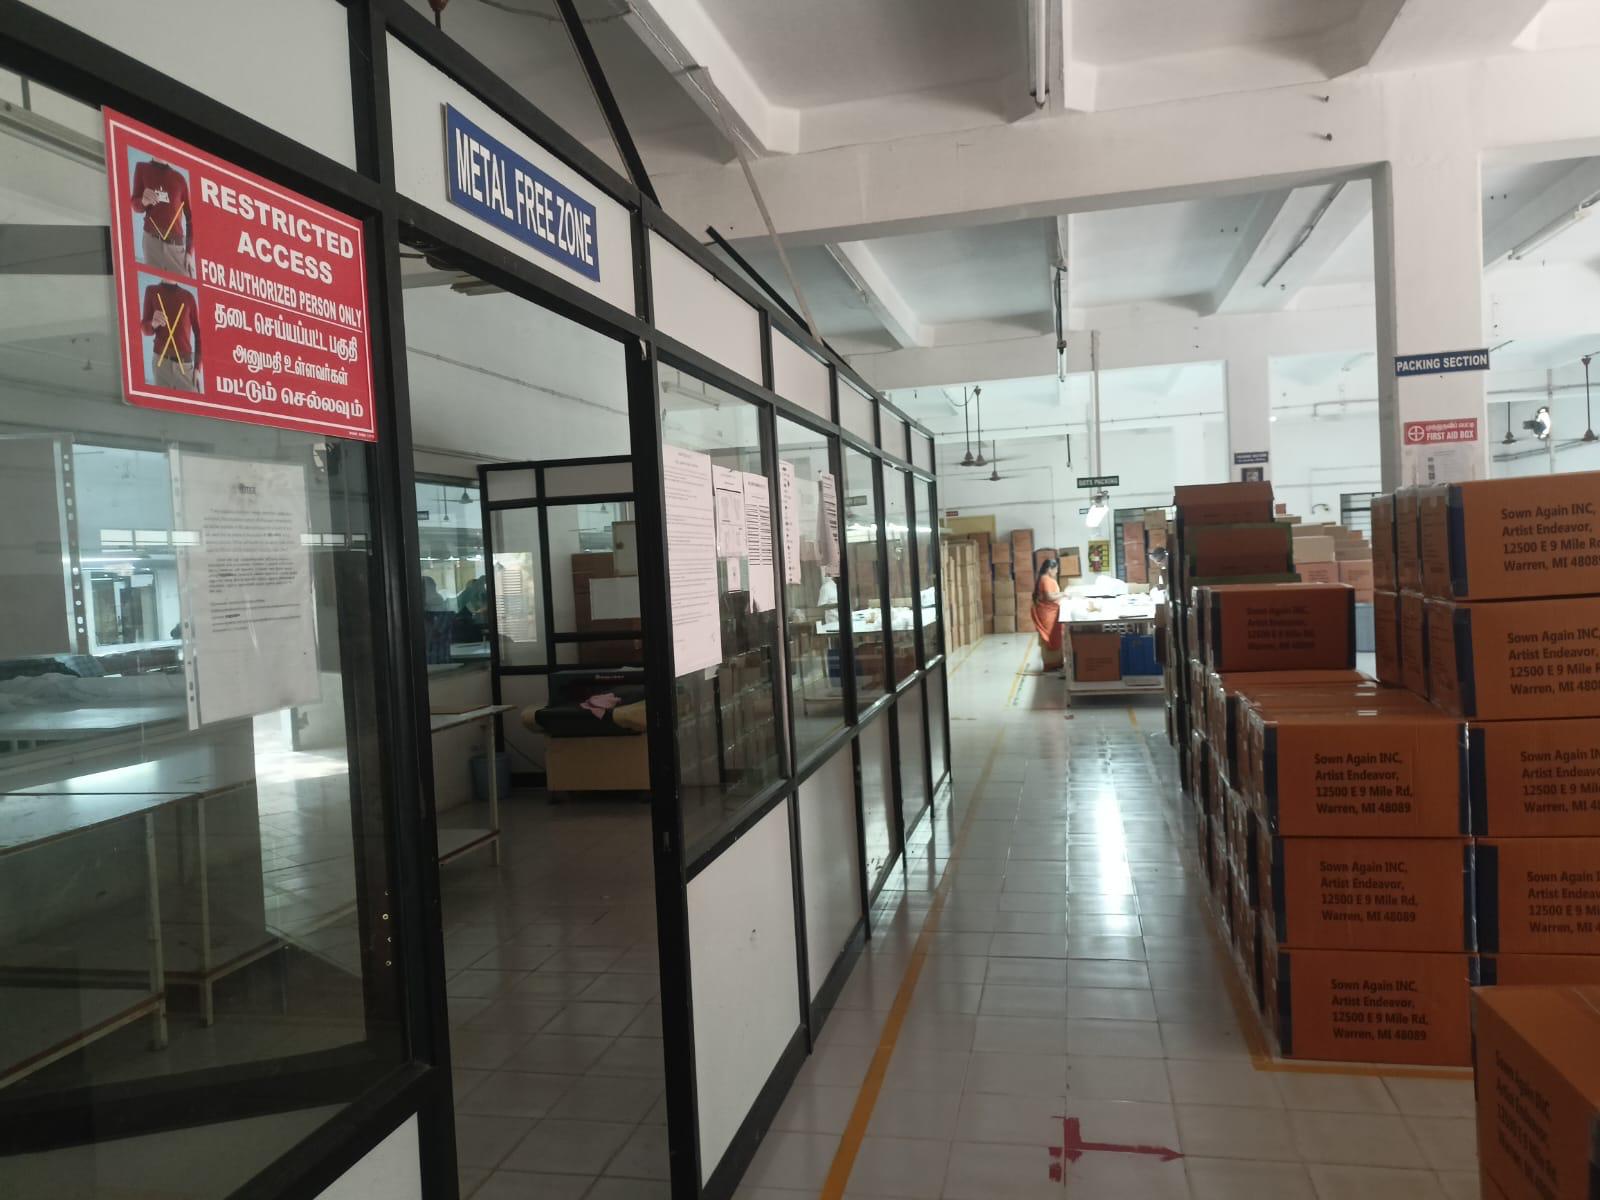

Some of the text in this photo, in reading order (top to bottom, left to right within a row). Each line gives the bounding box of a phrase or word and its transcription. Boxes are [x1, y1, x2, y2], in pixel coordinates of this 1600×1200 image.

[456, 127, 593, 266] METAL FREE ZONE
[200, 177, 354, 259] RESTRICTED
[237, 231, 333, 285] ACCESS
[202, 259, 361, 328] FOR AUTHORIZED PERSON ONLY
[214, 303, 358, 362] தடை செய்யப்பட்ட பகுதி
[232, 345, 348, 386] அனுமதி உள்ளவர்கள்
[1396, 354, 1487, 372] PACKING SECTION
[216, 375, 364, 419] மட்டும் செல்லவும்
[1426, 430, 1474, 440] FIRST AID BOX
[1501, 502, 1596, 520] Sown Again INC,
[1502, 521, 1593, 537] Artist Endeavor,
[1504, 542, 1537, 554] 12500
[1540, 540, 1547, 552] E
[1550, 540, 1557, 551] 9
[1561, 538, 1585, 551] Mile
[1504, 559, 1549, 572] Warren,
[1552, 556, 1567, 569] MI
[1507, 632, 1538, 644] Sown
[1542, 629, 1574, 644] Again
[1509, 647, 1599, 661] Artist Endeavor,
[1510, 665, 1544, 678] 12500
[1547, 664, 1554, 676] E
[1557, 664, 1563, 676] 9
[1567, 662, 1592, 674] Mile
[1510, 683, 1555, 695] Warren,
[1559, 681, 1574, 692] MI
[1314, 753, 1342, 764] Sown
[1346, 752, 1377, 767] Again
[1520, 751, 1552, 762] Sown
[1555, 748, 1587, 763] Again
[1315, 769, 1399, 782] Artist Endeavor,
[1522, 767, 1552, 779] Artist
[1316, 785, 1348, 797] 12500
[1351, 786, 1357, 797] E
[1360, 786, 1366, 797] 9
[1369, 785, 1393, 797] Mile
[1522, 784, 1557, 796] 12500
[1560, 783, 1567, 795] E
[1570, 783, 1576, 794] 9
[1361, 802, 1376, 813] MI
[1378, 801, 1411, 813] 48089
[1572, 799, 1587, 812] MI
[1320, 860, 1348, 872] Sown
[1351, 860, 1382, 875] Again
[1320, 877, 1349, 889] Artist
[1527, 871, 1557, 882] Sown
[1560, 870, 1593, 885] Again
[1321, 893, 1353, 905] 12500
[1356, 894, 1362, 905] E
[1365, 894, 1371, 905] 9
[1375, 894, 1397, 905] Mile
[1528, 888, 1558, 899] Artist
[1367, 911, 1381, 922] MI
[1528, 904, 1562, 916] 12500
[1566, 905, 1572, 916] E
[1576, 905, 1582, 916] 9
[1577, 921, 1592, 932] MI
[1331, 979, 1360, 991] Sown
[1362, 980, 1393, 993] Again
[1331, 995, 1360, 1006] Artist
[1332, 1011, 1364, 1022] 12500
[1367, 1012, 1373, 1023] E
[1376, 1013, 1382, 1024] 9
[1385, 1013, 1408, 1024] Mile
[1377, 1029, 1392, 1040] MI
[1394, 1030, 1427, 1040] 48089
